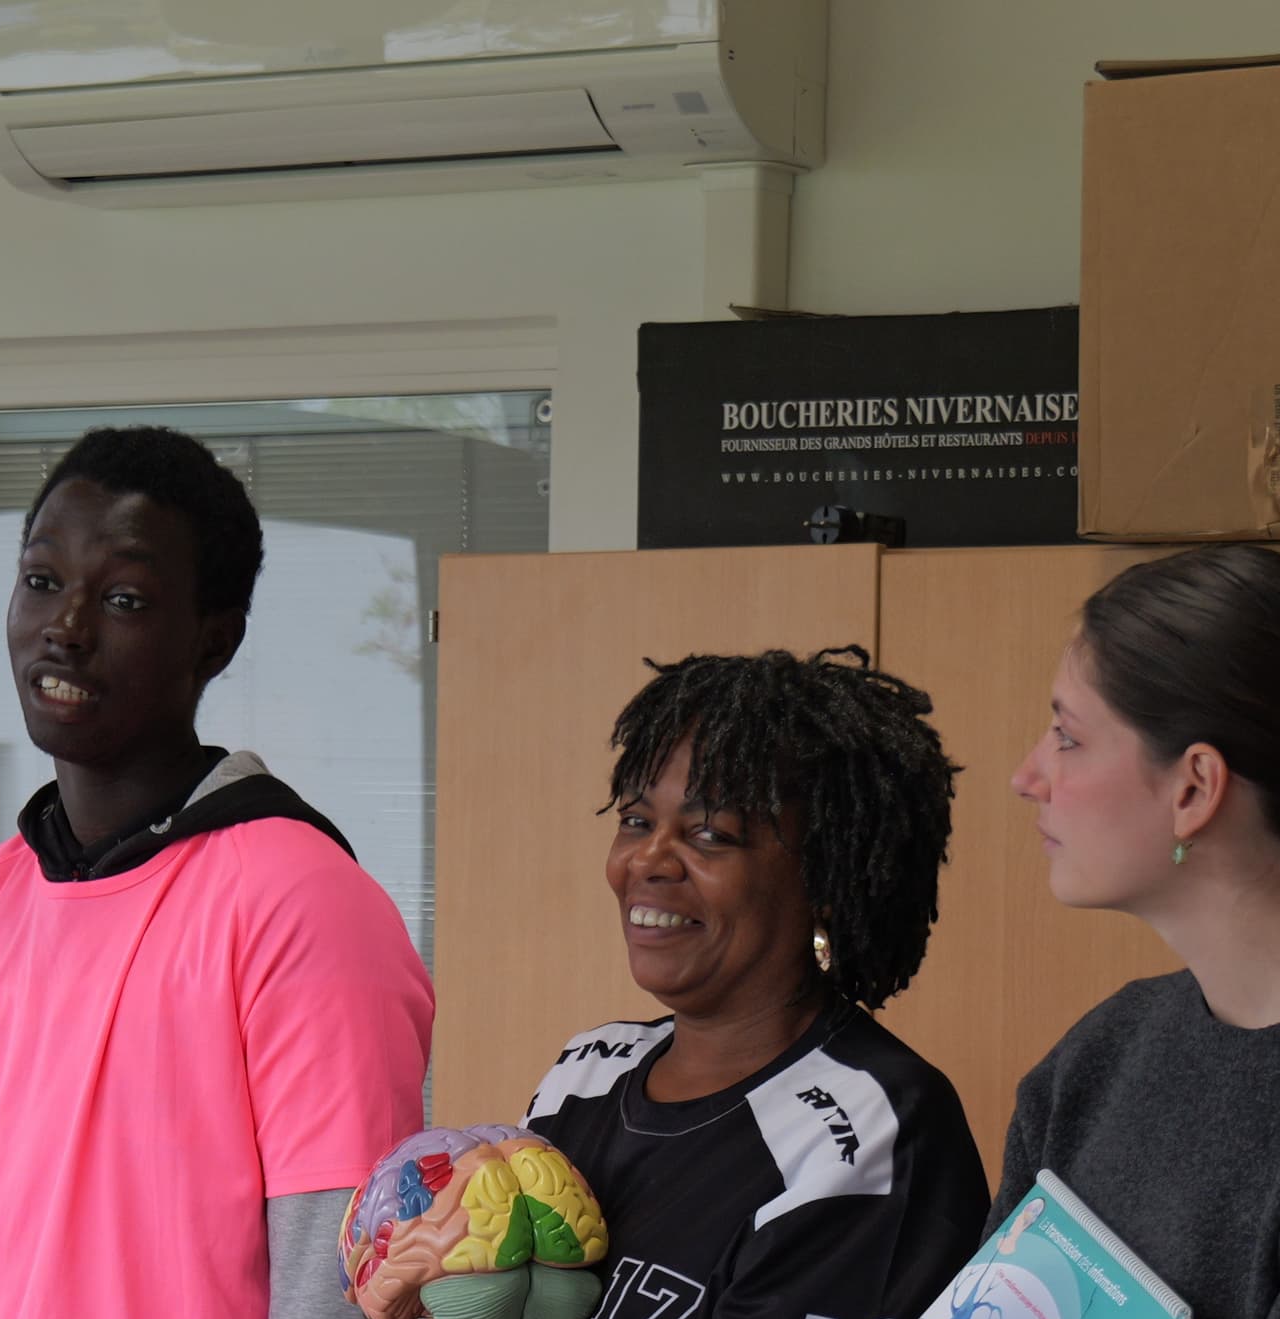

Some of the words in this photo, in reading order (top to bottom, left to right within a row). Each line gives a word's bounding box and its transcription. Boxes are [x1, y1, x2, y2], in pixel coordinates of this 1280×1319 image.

[722, 398, 899, 430] BOUCHERIES
[905, 394, 1078, 425] NIVERNAISE
[721, 438, 799, 453] FOURNISSEUR
[800, 437, 822, 450] DES
[824, 434, 872, 450] GRANDS
[874, 432, 919, 449] HÔTELS
[921, 433, 936, 448] ET
[938, 432, 1023, 447] RESTAURANTS
[1025, 431, 1069, 445] DEPUIS
[1043, 1221, 1085, 1263] transmission
[1075, 1253, 1094, 1272] des
[1085, 1262, 1131, 1307] informations
